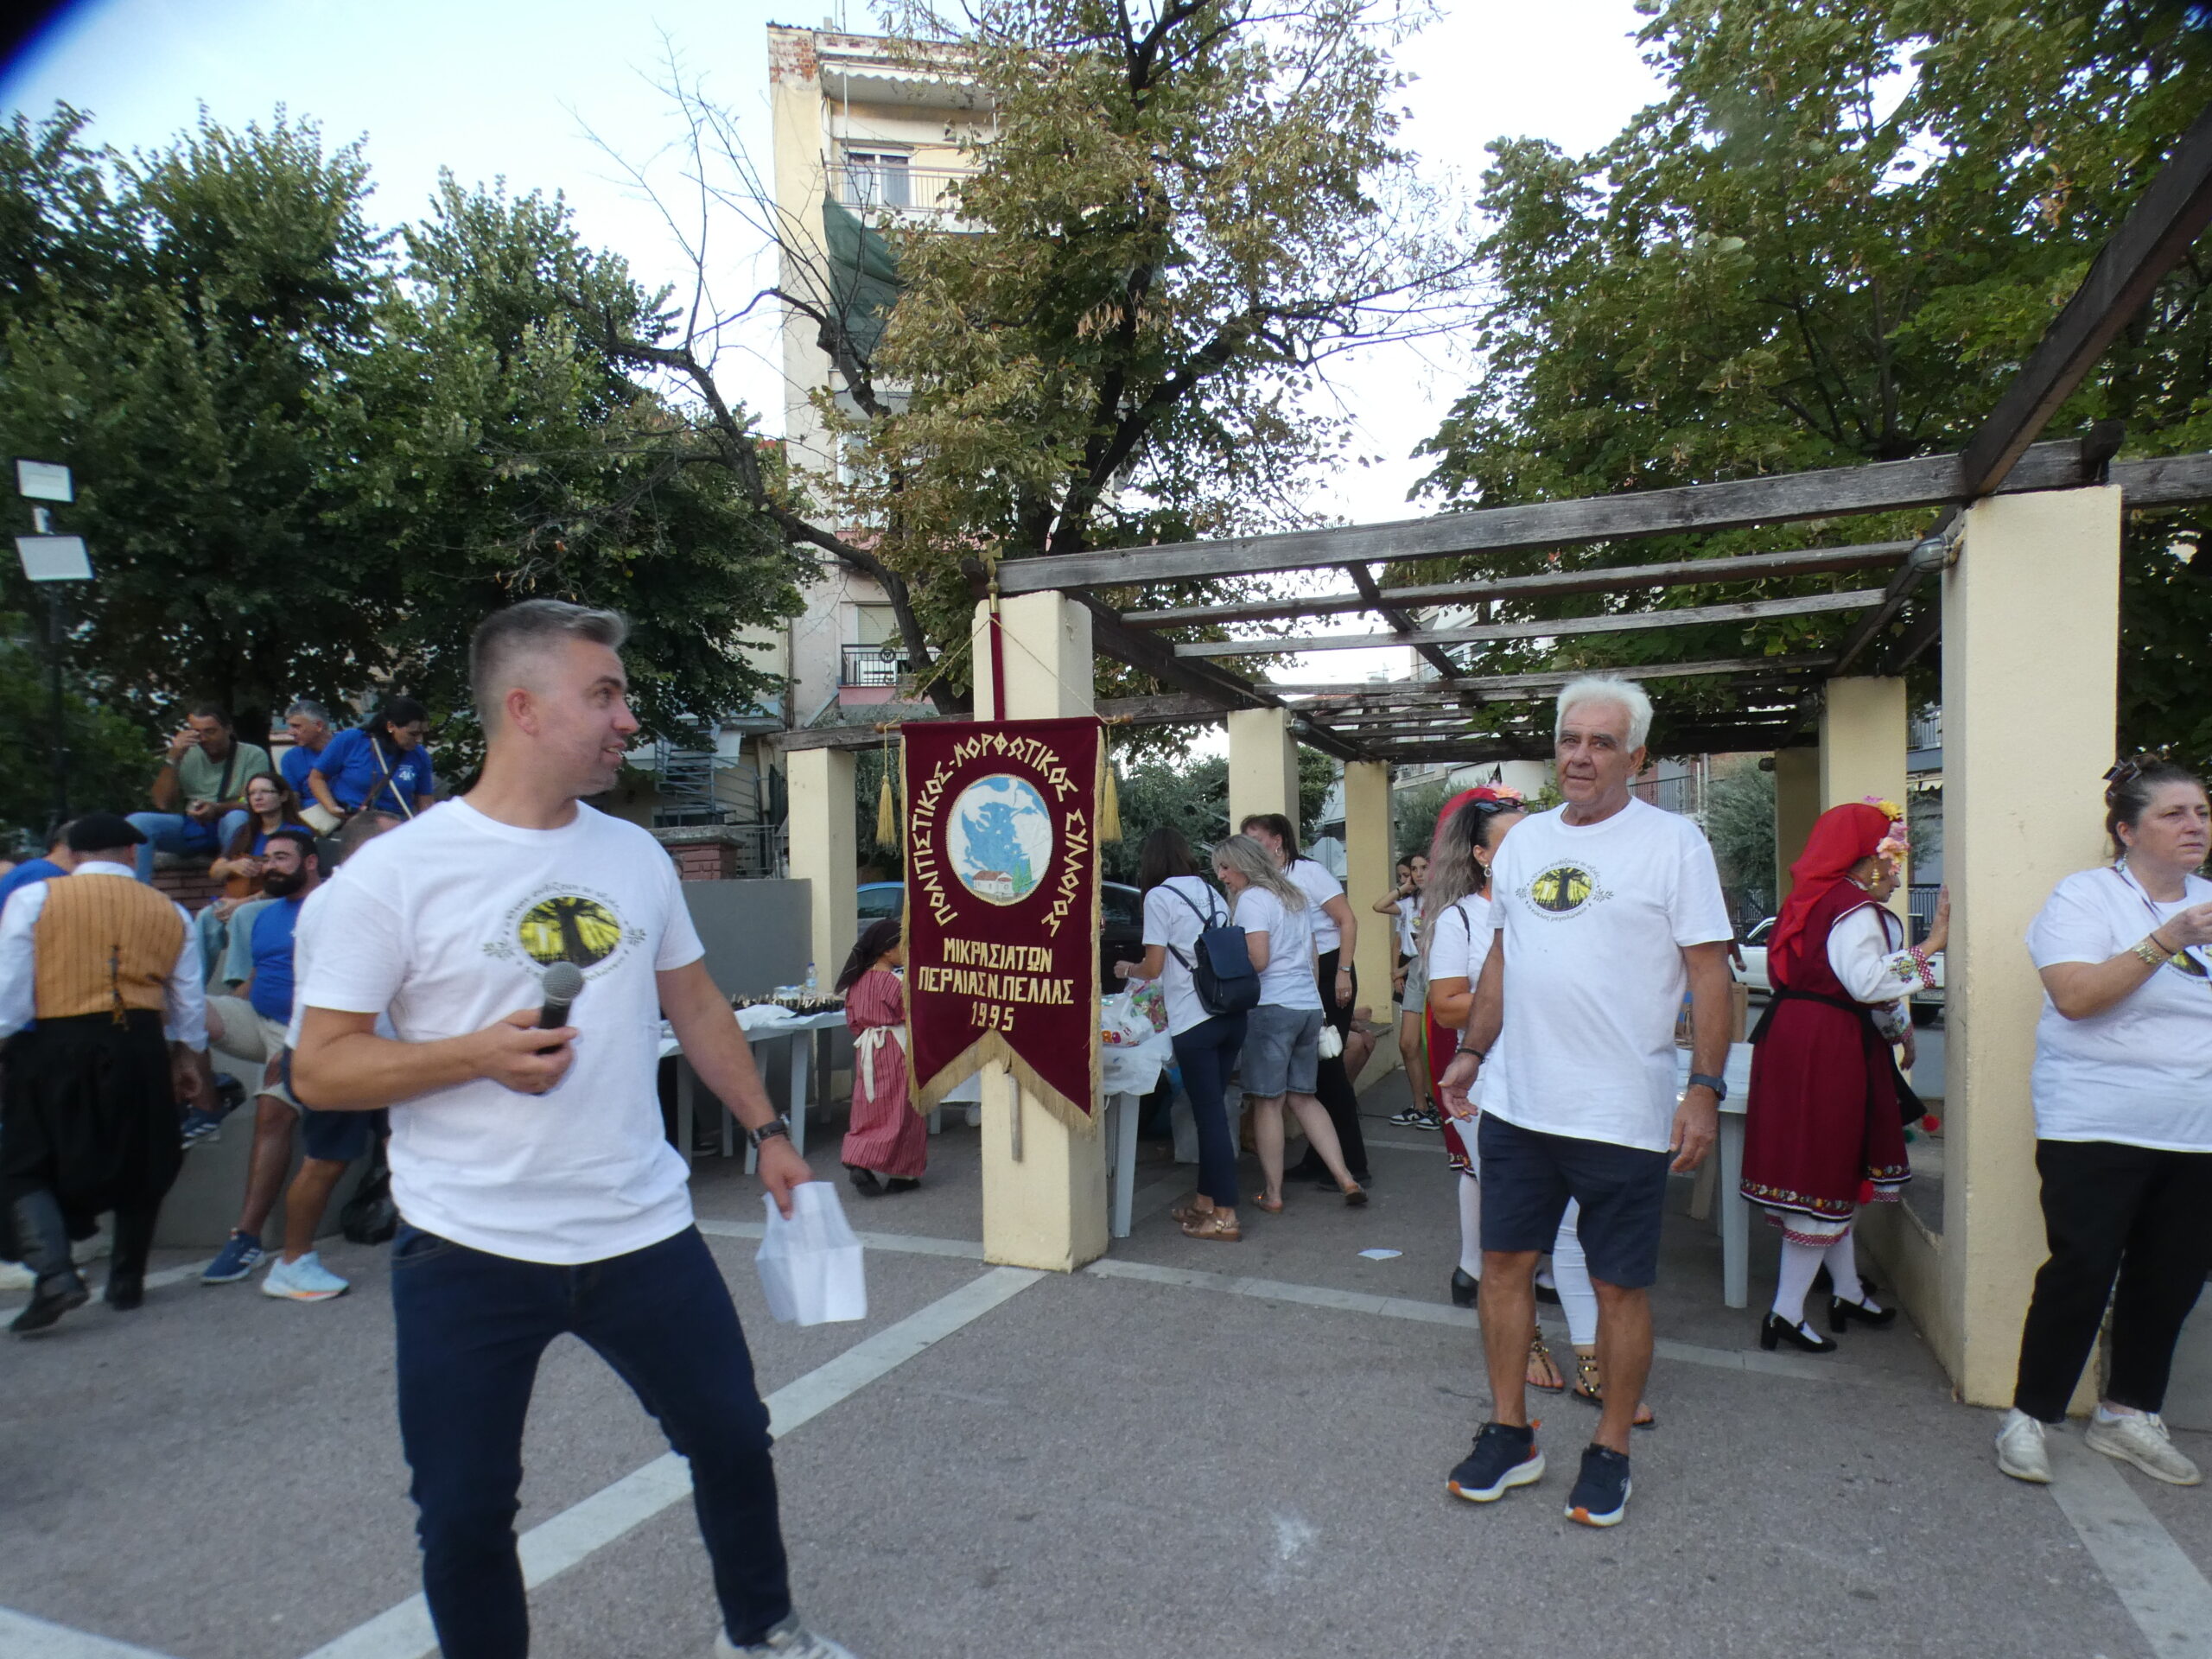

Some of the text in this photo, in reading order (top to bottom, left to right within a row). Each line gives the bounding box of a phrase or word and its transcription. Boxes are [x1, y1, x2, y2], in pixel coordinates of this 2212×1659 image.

[1041, 808, 1088, 938] ΣΥΛΛΟΓΟΣ
[943, 938, 1052, 973] ΜΙΚΡΑΣΙΑΤΩΝ
[970, 1001, 1014, 1032] 1995
